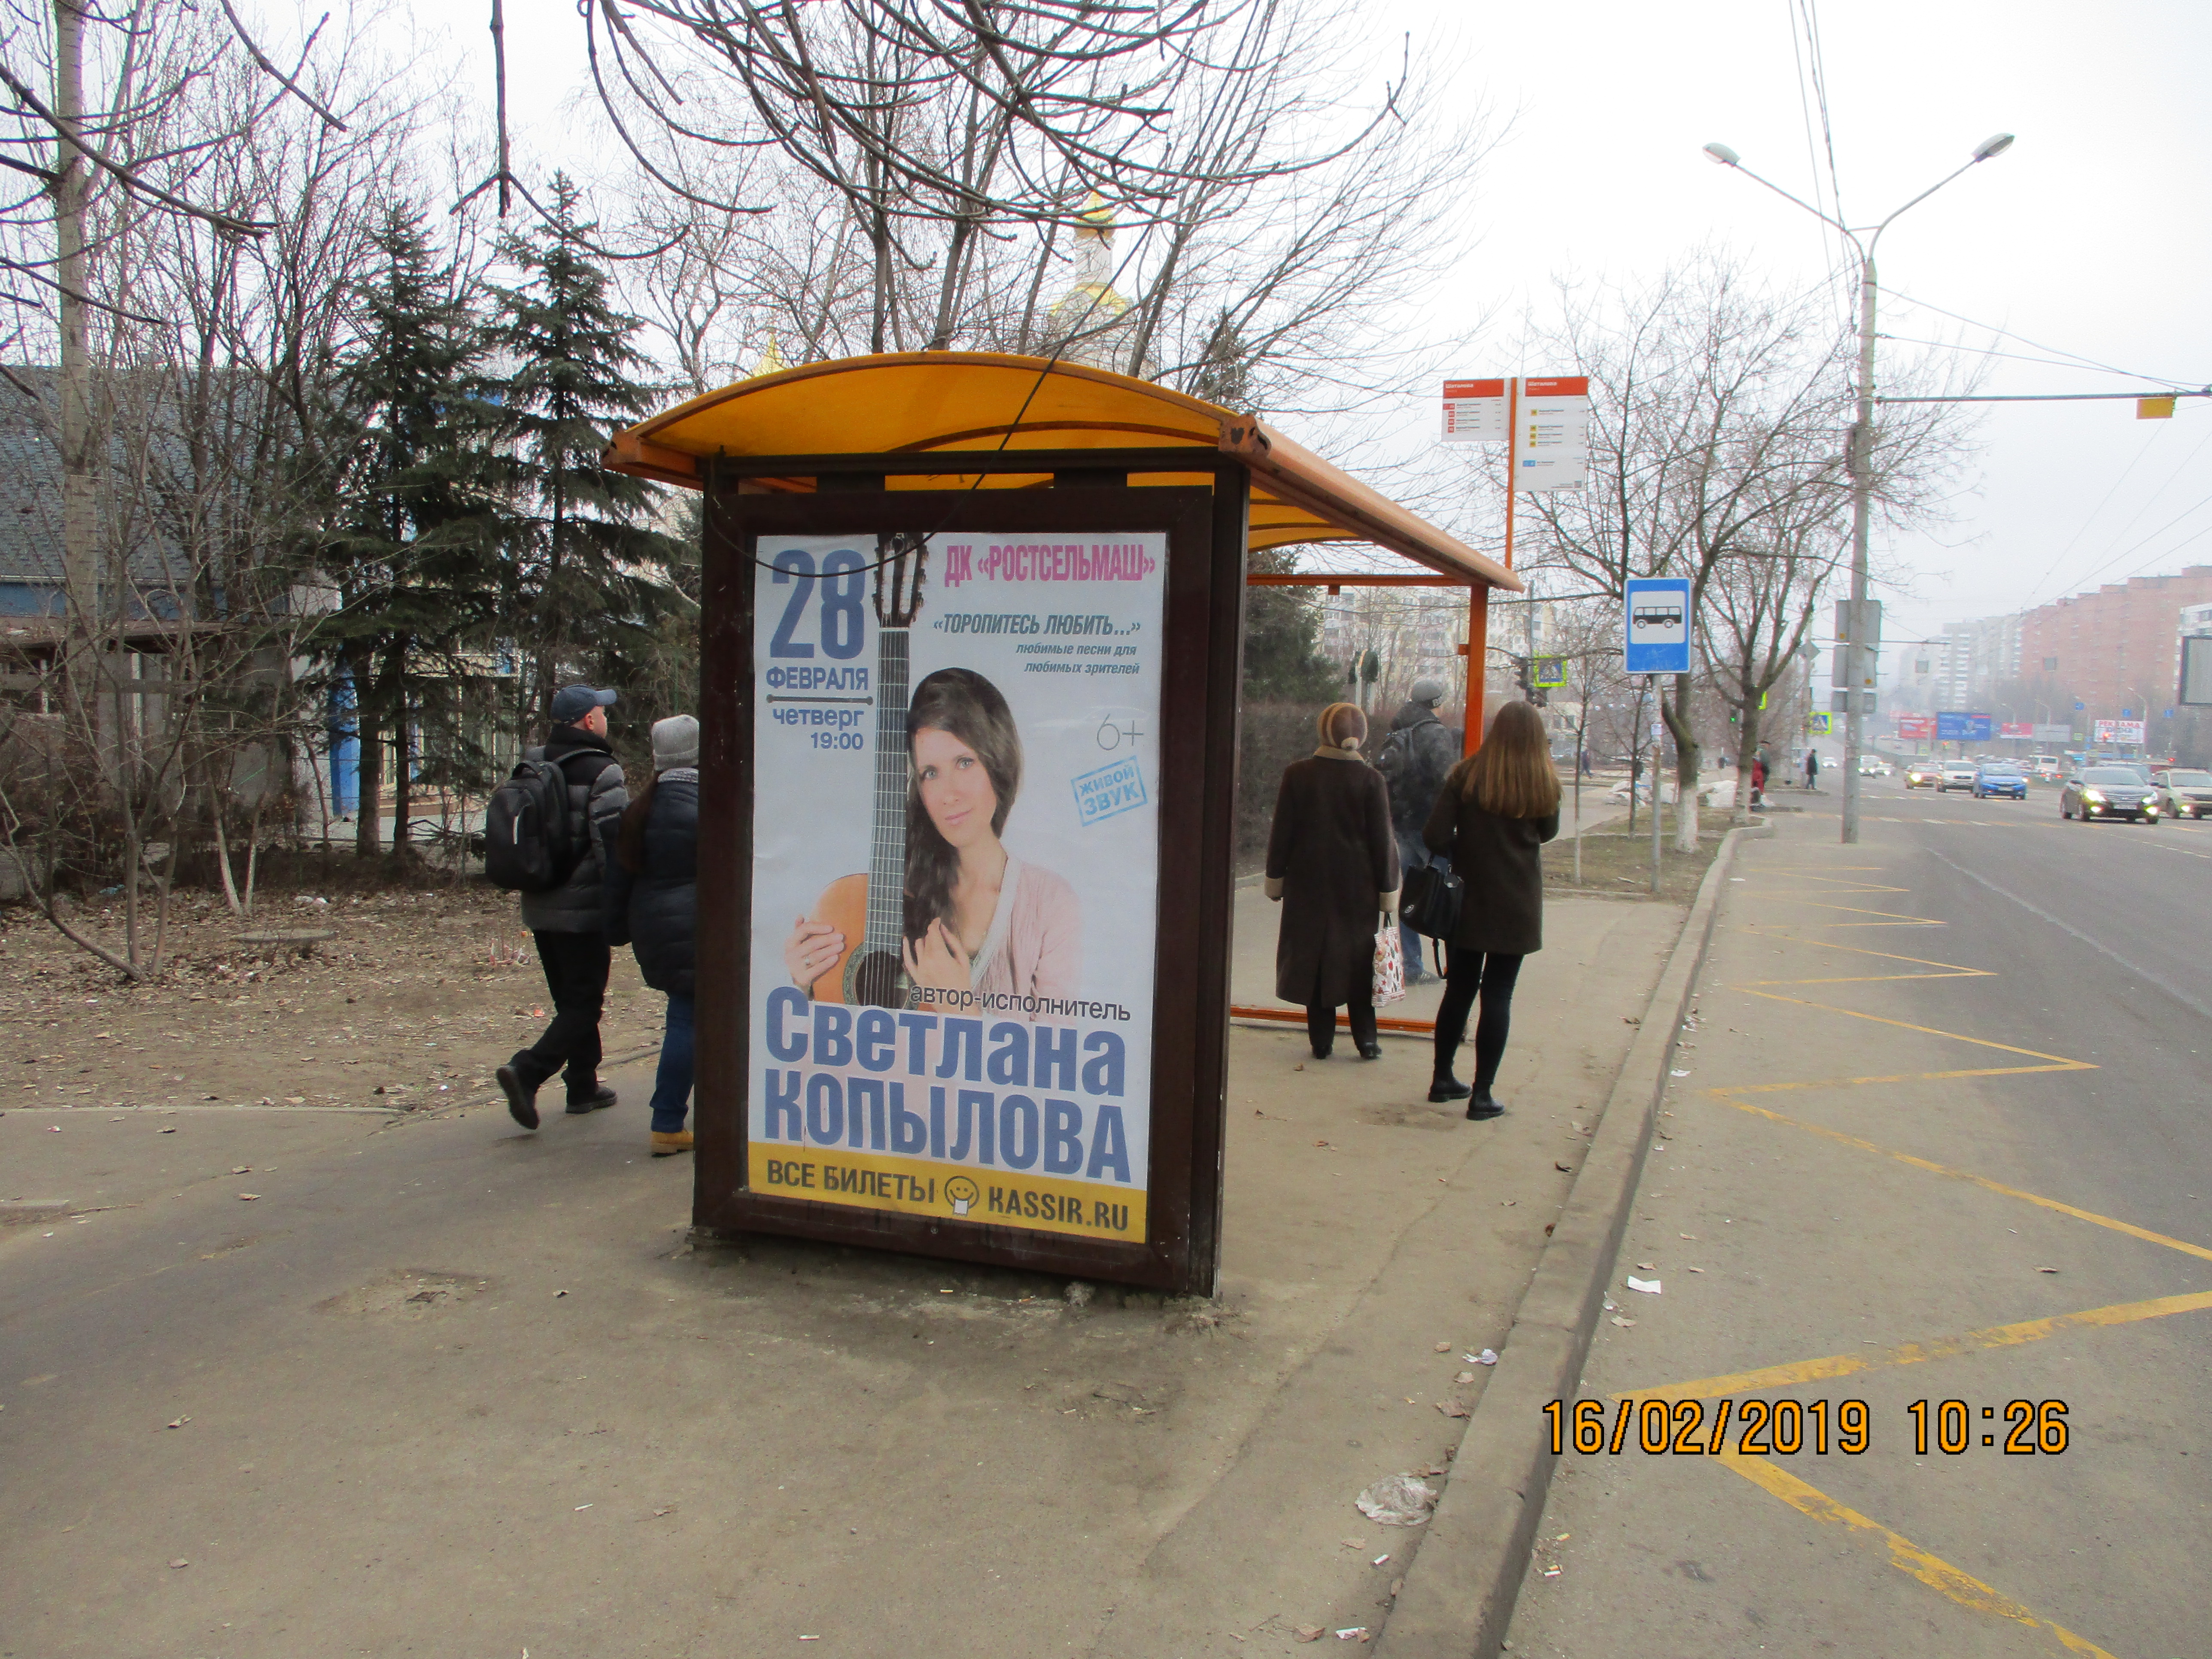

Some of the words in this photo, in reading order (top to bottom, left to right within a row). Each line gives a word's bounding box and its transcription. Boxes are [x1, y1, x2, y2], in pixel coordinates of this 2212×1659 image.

[944, 545, 973, 587] ДК
[977, 544, 1156, 581] «РОСТСЕЛЬМАШ»
[770, 549, 866, 659] 28
[933, 614, 1040, 634] «ТОРОПИТЕСЬ
[1015, 643, 1074, 655] любимые
[1076, 644, 1112, 656] песни
[1112, 645, 1137, 657] для
[766, 666, 869, 690] ФЕВРАЛЯ
[1024, 661, 1082, 674] любимых
[1085, 662, 1140, 676] зрителей
[773, 708, 864, 731] четверг
[1097, 713, 1144, 751] 6+
[811, 732, 864, 750] 19:00
[1079, 764, 1135, 796] ЖИВОЙ
[1083, 781, 1140, 815] ЗВУК
[910, 986, 1131, 1021] автор-исполнитель
[766, 986, 1126, 1097] Светлана
[764, 1068, 1131, 1183] КОПЫЛОВА
[767, 1159, 815, 1189] ВСЕ
[824, 1165, 935, 1203] БИЛЕТЫ
[988, 1186, 1128, 1231] KASSIR.RU
